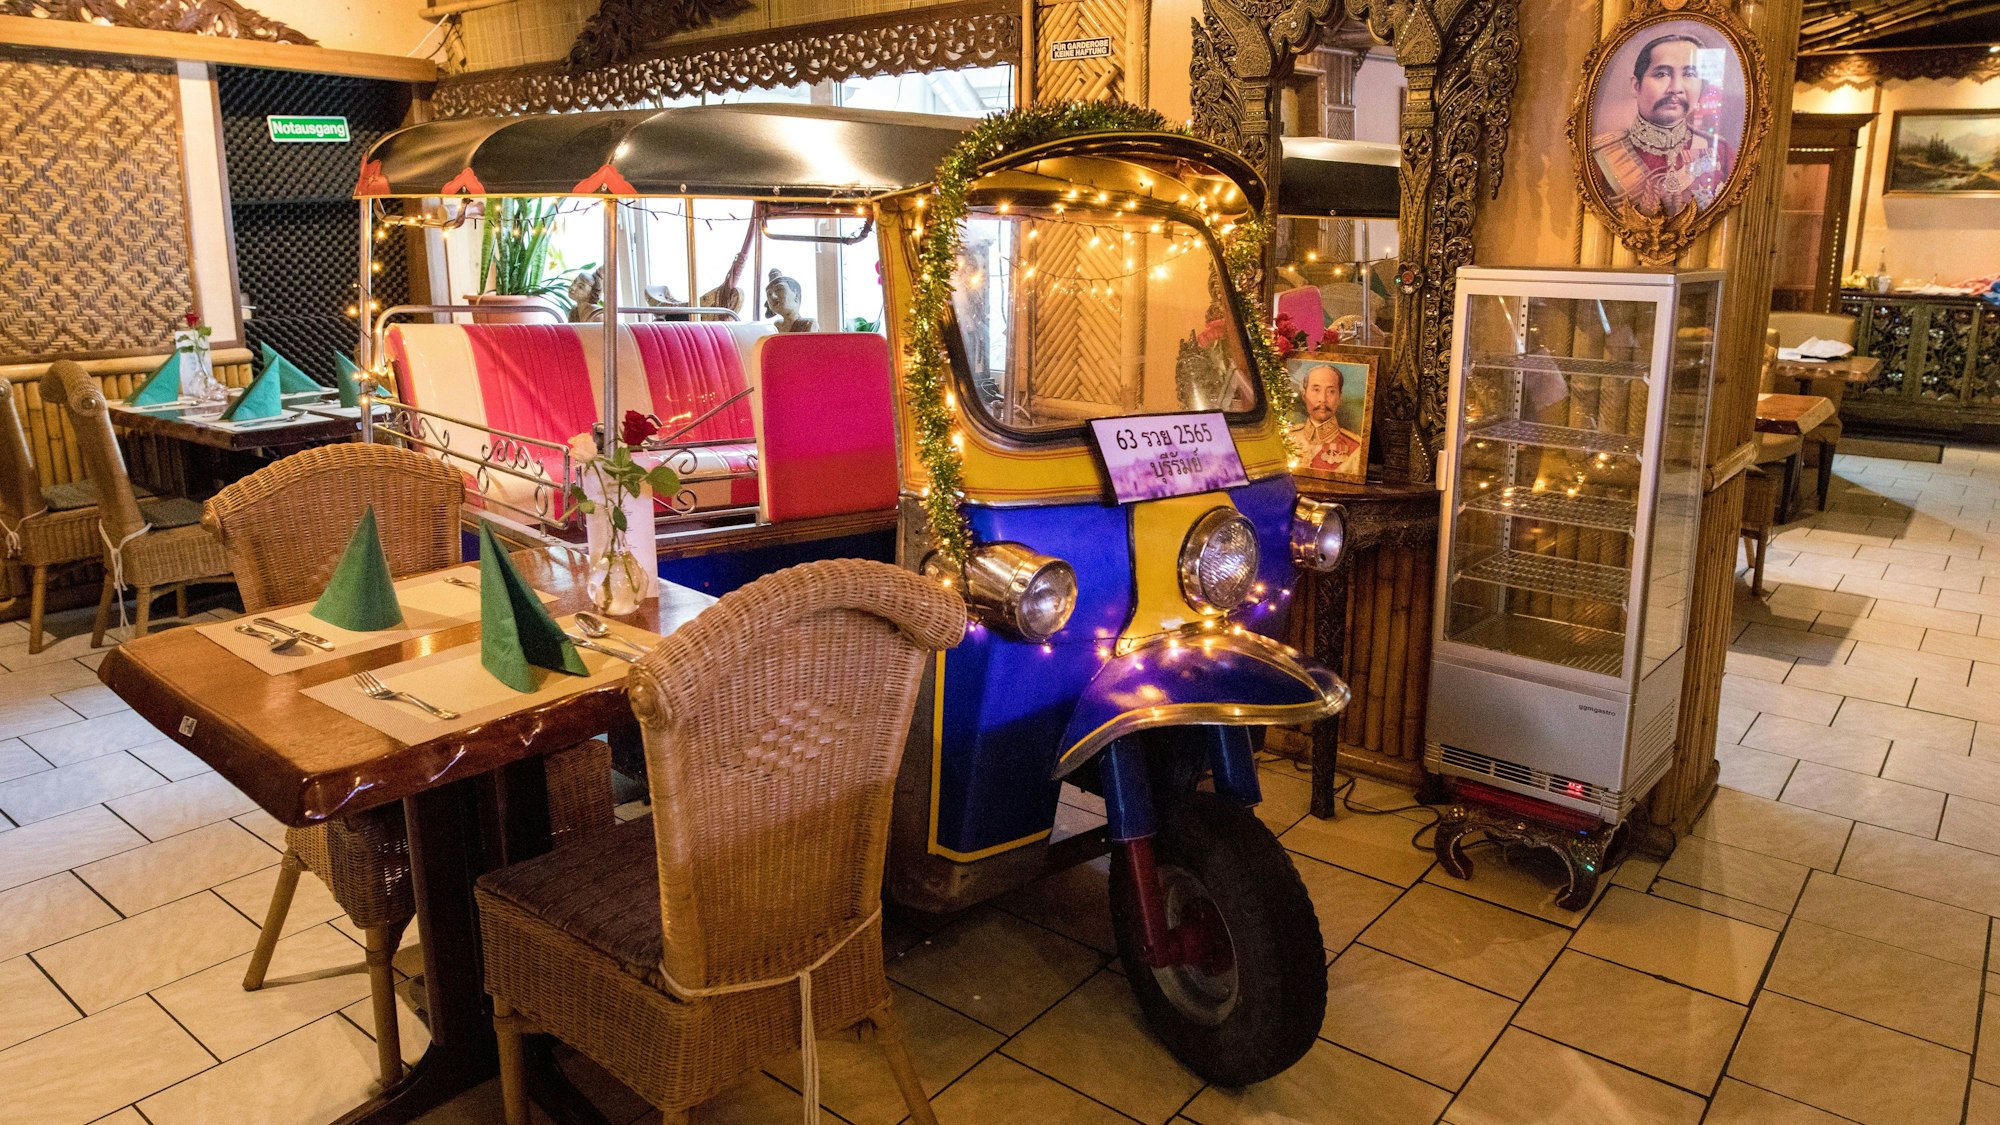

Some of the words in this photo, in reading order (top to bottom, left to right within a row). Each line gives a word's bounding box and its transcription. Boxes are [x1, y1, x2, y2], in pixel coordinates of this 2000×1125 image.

[1053, 42, 1066, 51] FÜR
[1067, 39, 1109, 50] GARDEROBE
[1054, 49, 1075, 58] KEINE
[1075, 46, 1107, 56] HAFTUNG
[271, 121, 346, 137] Notausgang
[1116, 429, 1138, 450] 63
[1141, 429, 1173, 447] รวย
[1173, 423, 1213, 445] 2565
[1150, 447, 1203, 484] บุรีรัมย์
